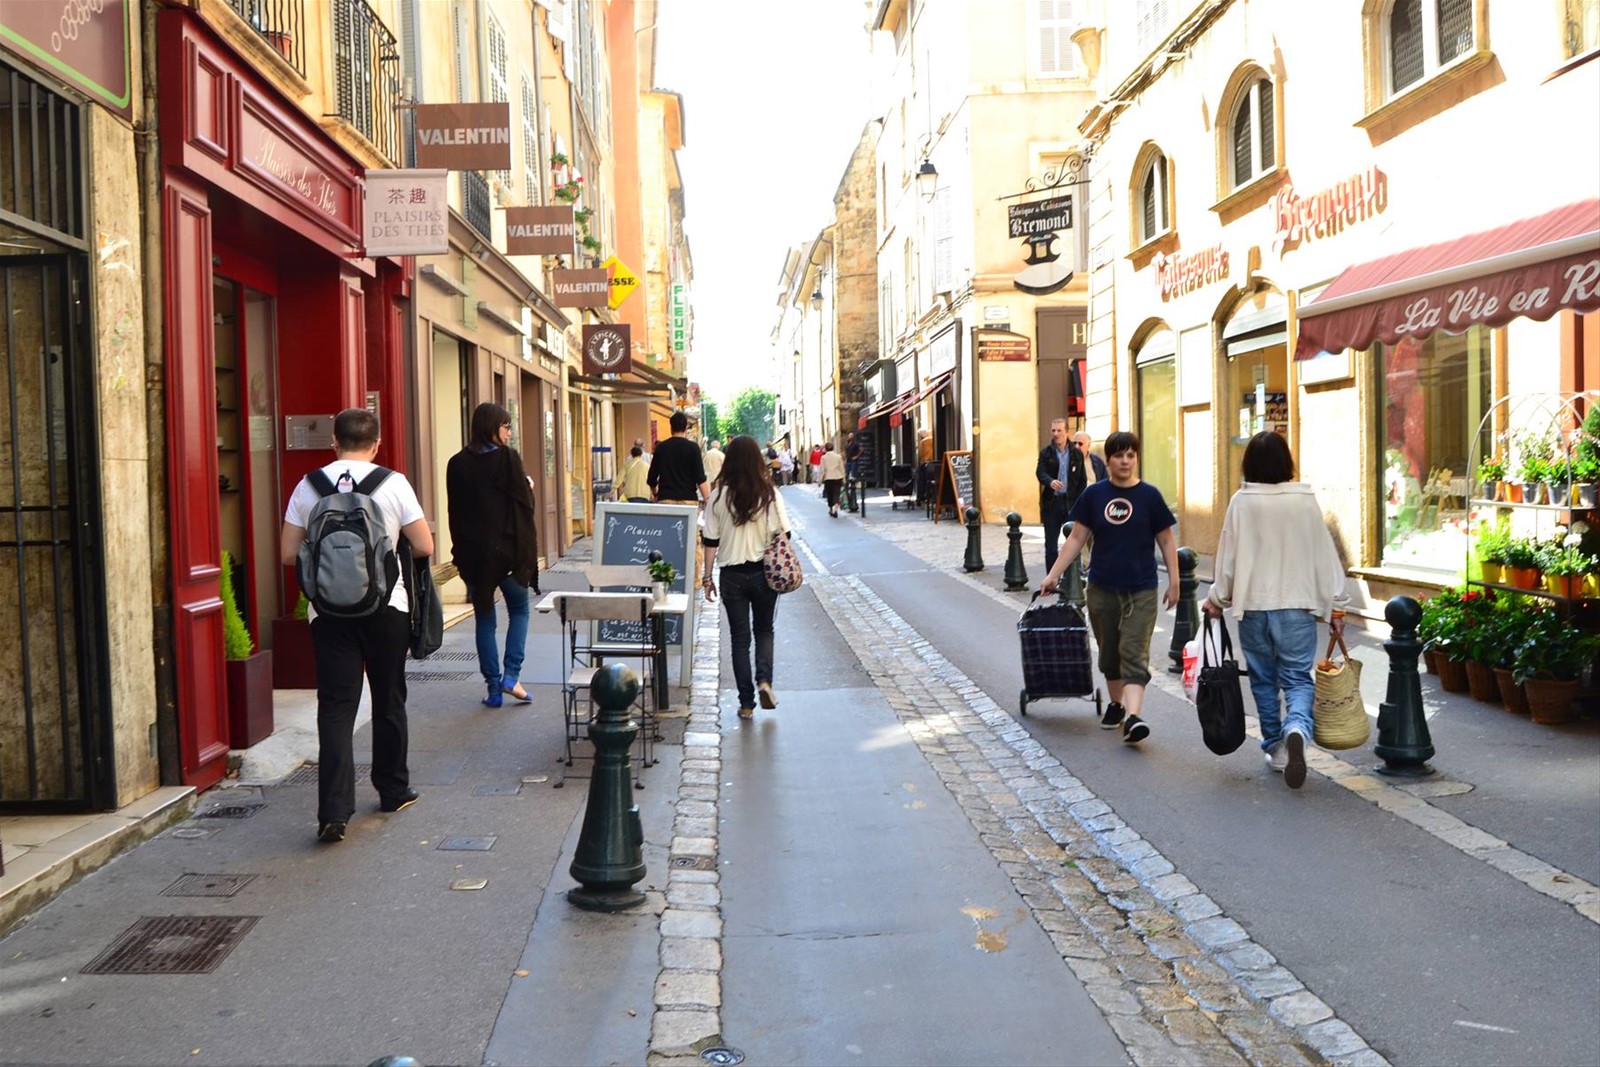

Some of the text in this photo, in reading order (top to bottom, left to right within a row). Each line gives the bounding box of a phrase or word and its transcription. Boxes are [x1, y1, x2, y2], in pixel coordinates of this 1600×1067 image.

[419, 127, 509, 145] VALENTIN
[388, 188, 426, 205] 茶趣
[373, 210, 442, 224] PLAISIRS
[1010, 210, 1070, 236] Bremond
[372, 225, 400, 238] DES
[508, 223, 573, 238] VALENTIN
[555, 281, 608, 293] VALENTIN
[1394, 297, 1441, 334] La
[1447, 285, 1499, 324] Vie
[1508, 286, 1550, 312] en
[673, 284, 684, 352] FLEURS
[623, 524, 663, 537] Plaisirs
